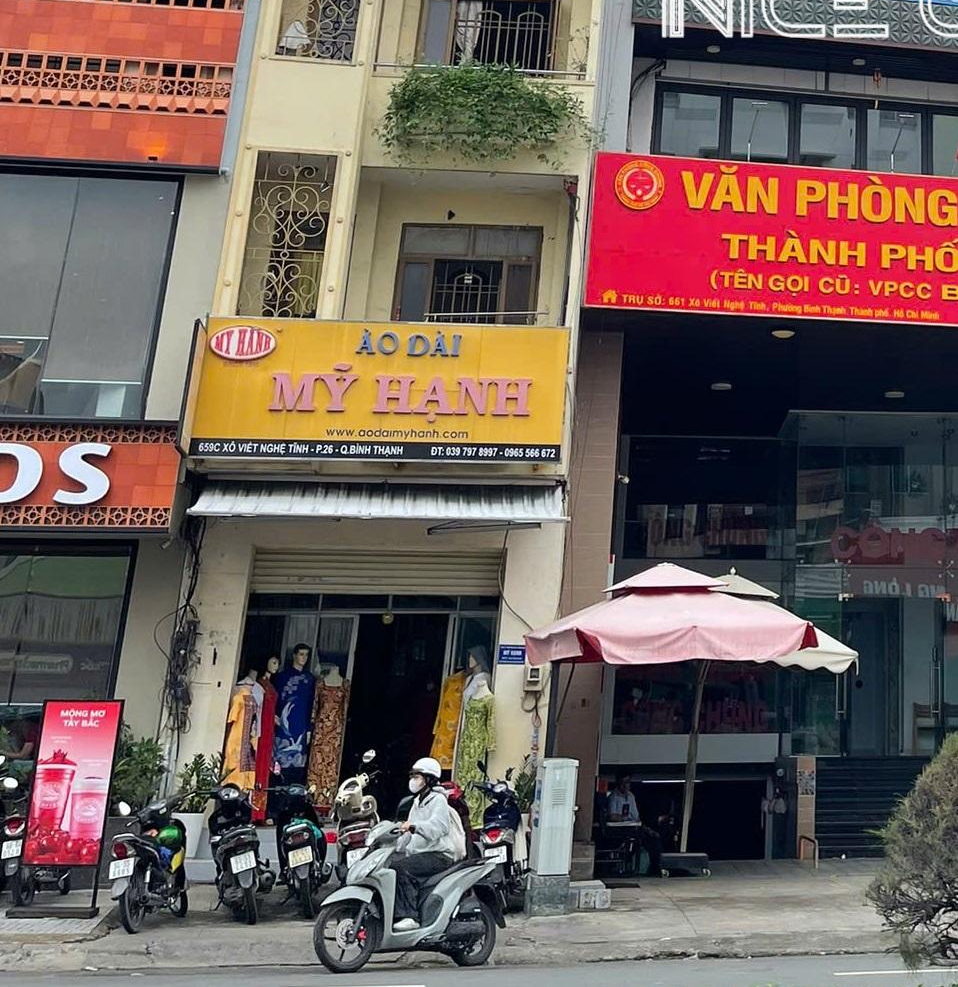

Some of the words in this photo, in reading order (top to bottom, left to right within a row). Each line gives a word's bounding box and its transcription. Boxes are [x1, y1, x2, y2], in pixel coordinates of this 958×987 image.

[681, 165, 779, 215] VĂN
[795, 176, 958, 226] PHÒNG
[722, 230, 866, 268] THÀNH
[710, 268, 763, 291] (TÊN
[768, 273, 809, 295] GỌI
[818, 273, 860, 296] CŨ:
[869, 280, 932, 300] VPCC
[668, 297, 685, 306] 661
[406, 330, 463, 358] DÀI
[268, 363, 359, 412] MỸ
[373, 375, 533, 423] HẠNH
[326, 427, 469, 440] www.aodaimyhanh.com
[199, 442, 220, 452] 659C
[373, 445, 403, 457] THẠNH
[446, 446, 460, 456] 039
[462, 447, 476, 457] 797
[478, 447, 497, 457] 8997
[504, 447, 524, 457] 0965
[525, 448, 540, 458] 566
[541, 448, 556, 458] 672
